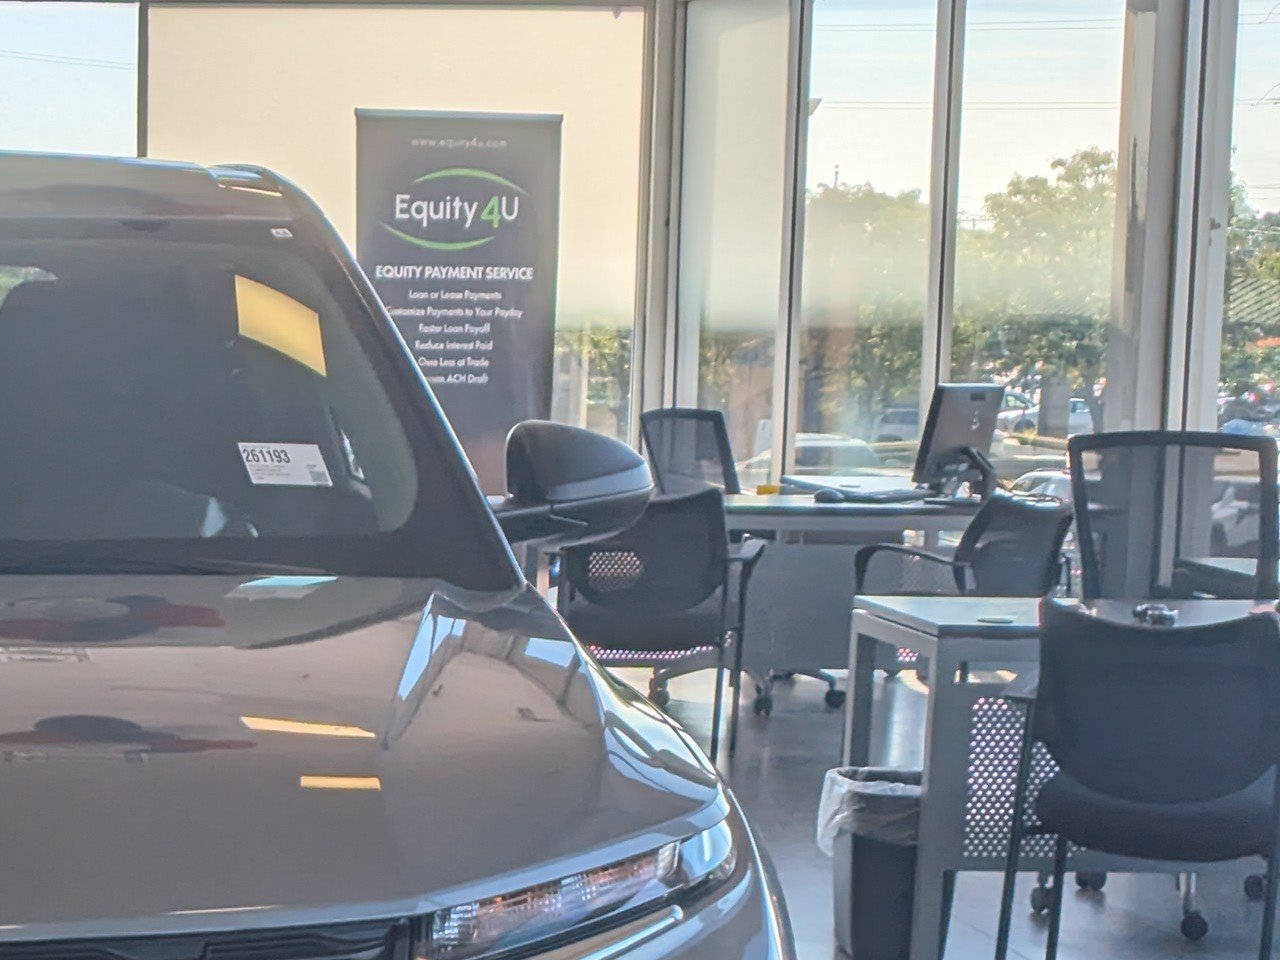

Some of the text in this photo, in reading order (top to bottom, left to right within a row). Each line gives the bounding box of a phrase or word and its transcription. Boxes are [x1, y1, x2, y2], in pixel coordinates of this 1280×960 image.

[375, 265, 534, 281] EQUITY PAYMENT SERVICE
[409, 289, 429, 299] Loan
[440, 290, 463, 299] Lease
[464, 290, 502, 301] Payments
[427, 306, 464, 318] Payments
[465, 308, 473, 316] to
[475, 307, 493, 317] Your
[494, 307, 523, 319] Payday
[419, 323, 491, 336] Faster Loan Payoff
[415, 340, 493, 350] Reduce Interest Paid
[439, 357, 455, 367] Less
[456, 358, 466, 367] at
[467, 357, 489, 367] Trade
[446, 373, 466, 384] ACH
[467, 373, 488, 384] Draft
[243, 448, 291, 464] 261193
